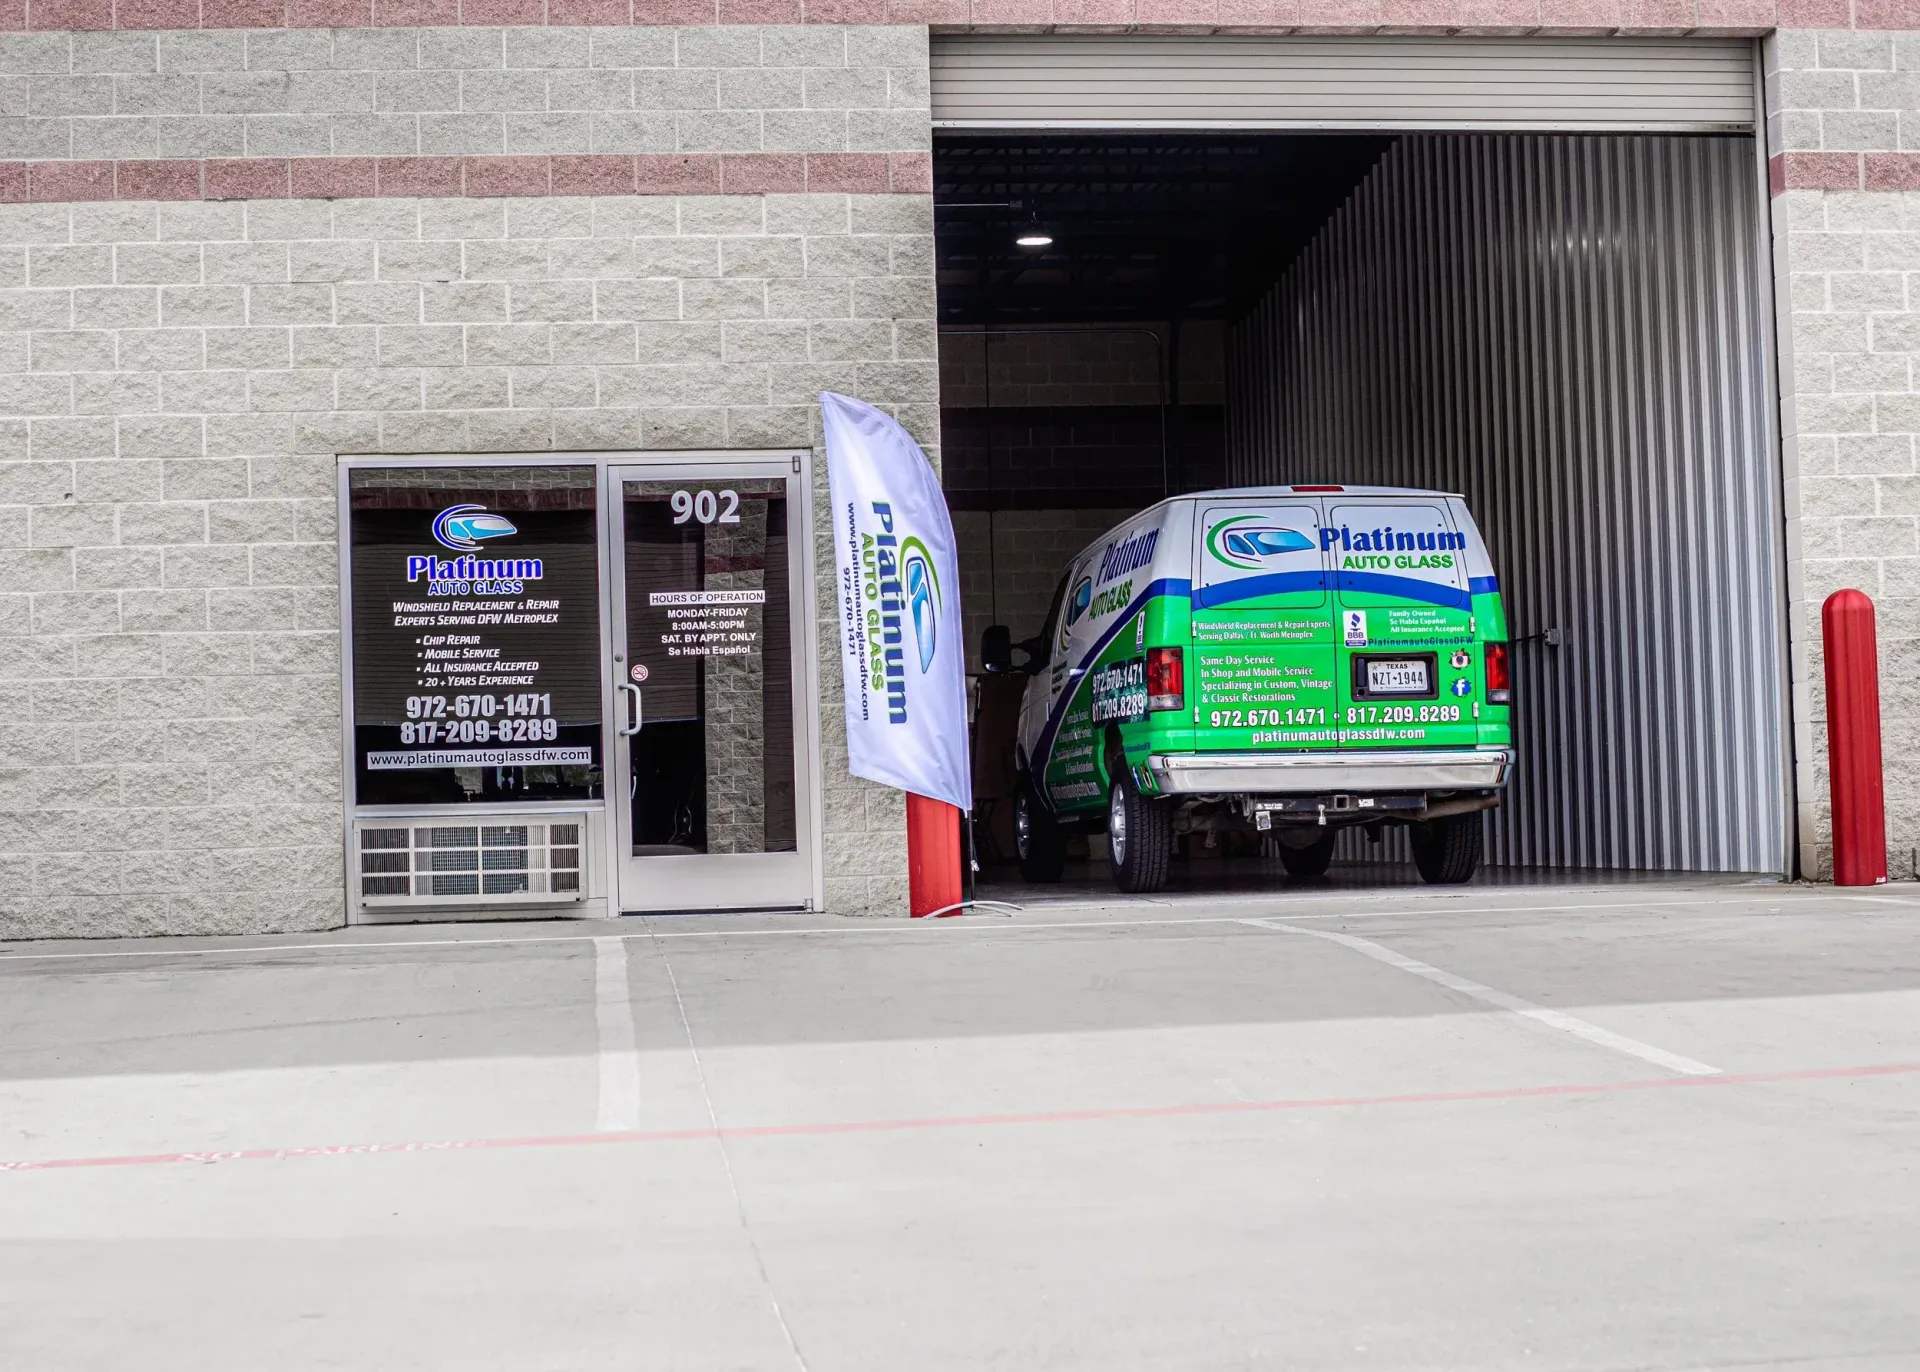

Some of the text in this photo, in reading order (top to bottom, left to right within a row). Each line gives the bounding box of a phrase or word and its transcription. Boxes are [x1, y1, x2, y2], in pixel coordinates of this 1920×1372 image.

[670, 489, 740, 524] 902
[1320, 525, 1466, 552] Platinum
[1096, 528, 1160, 587] Platinum
[1343, 554, 1453, 569] AUTO GLASS
[407, 554, 543, 582] Platinum
[428, 580, 523, 595] AUTO GLASS
[652, 592, 763, 604] HOURS OF OPERATION
[1088, 579, 1133, 622] AUTO GLASS
[393, 599, 559, 613] WINDSHIELD REPLACEMENT & REPAIR
[667, 608, 748, 618] MONDAY-FRIDAY
[843, 567, 856, 656] 972-670-1471
[847, 502, 869, 721] www.platinumautoglassdfw.com
[861, 532, 884, 692] AUTO GLASS
[871, 501, 907, 724] Platinum
[394, 613, 559, 627] EXPERTS SERVING DFW METROPLEX
[672, 620, 745, 631] 8:00AM-5:00PM
[1198, 620, 1331, 631] Windshield Replacement & Repair Experts
[1198, 632, 1223, 641] Serving
[1224, 631, 1244, 640] Dallas
[1260, 631, 1280, 639] Worth
[1281, 630, 1314, 640] Metroplex
[1434, 625, 1465, 634] Accepted
[423, 634, 480, 646] CHIP REPAIR
[661, 632, 756, 644] SAT. BY APPT. ONLY
[425, 648, 500, 660] MOBILE SERVICE
[668, 645, 750, 657] Se Habla Español
[424, 661, 539, 673] ALL INSURANCE ACCEPTED
[1200, 655, 1275, 666] Same Day Service
[1201, 666, 1314, 679] In Shop and Mobile Service
[425, 677, 438, 687] 20
[448, 676, 477, 687] YEARS
[478, 675, 534, 686] EXPERIENCE
[1201, 679, 1333, 692] Specializing in Custom, Vintage
[1202, 692, 1296, 703] & Classic Restorations
[406, 693, 551, 718] 972-670-1471
[1210, 705, 1460, 728] 972.670.1471 817.209.8289
[400, 718, 557, 744] 817-209-8289
[1252, 727, 1425, 745] platinumautoglassdfw.com
[370, 748, 589, 766] www.platinumautoglassdfw.com
